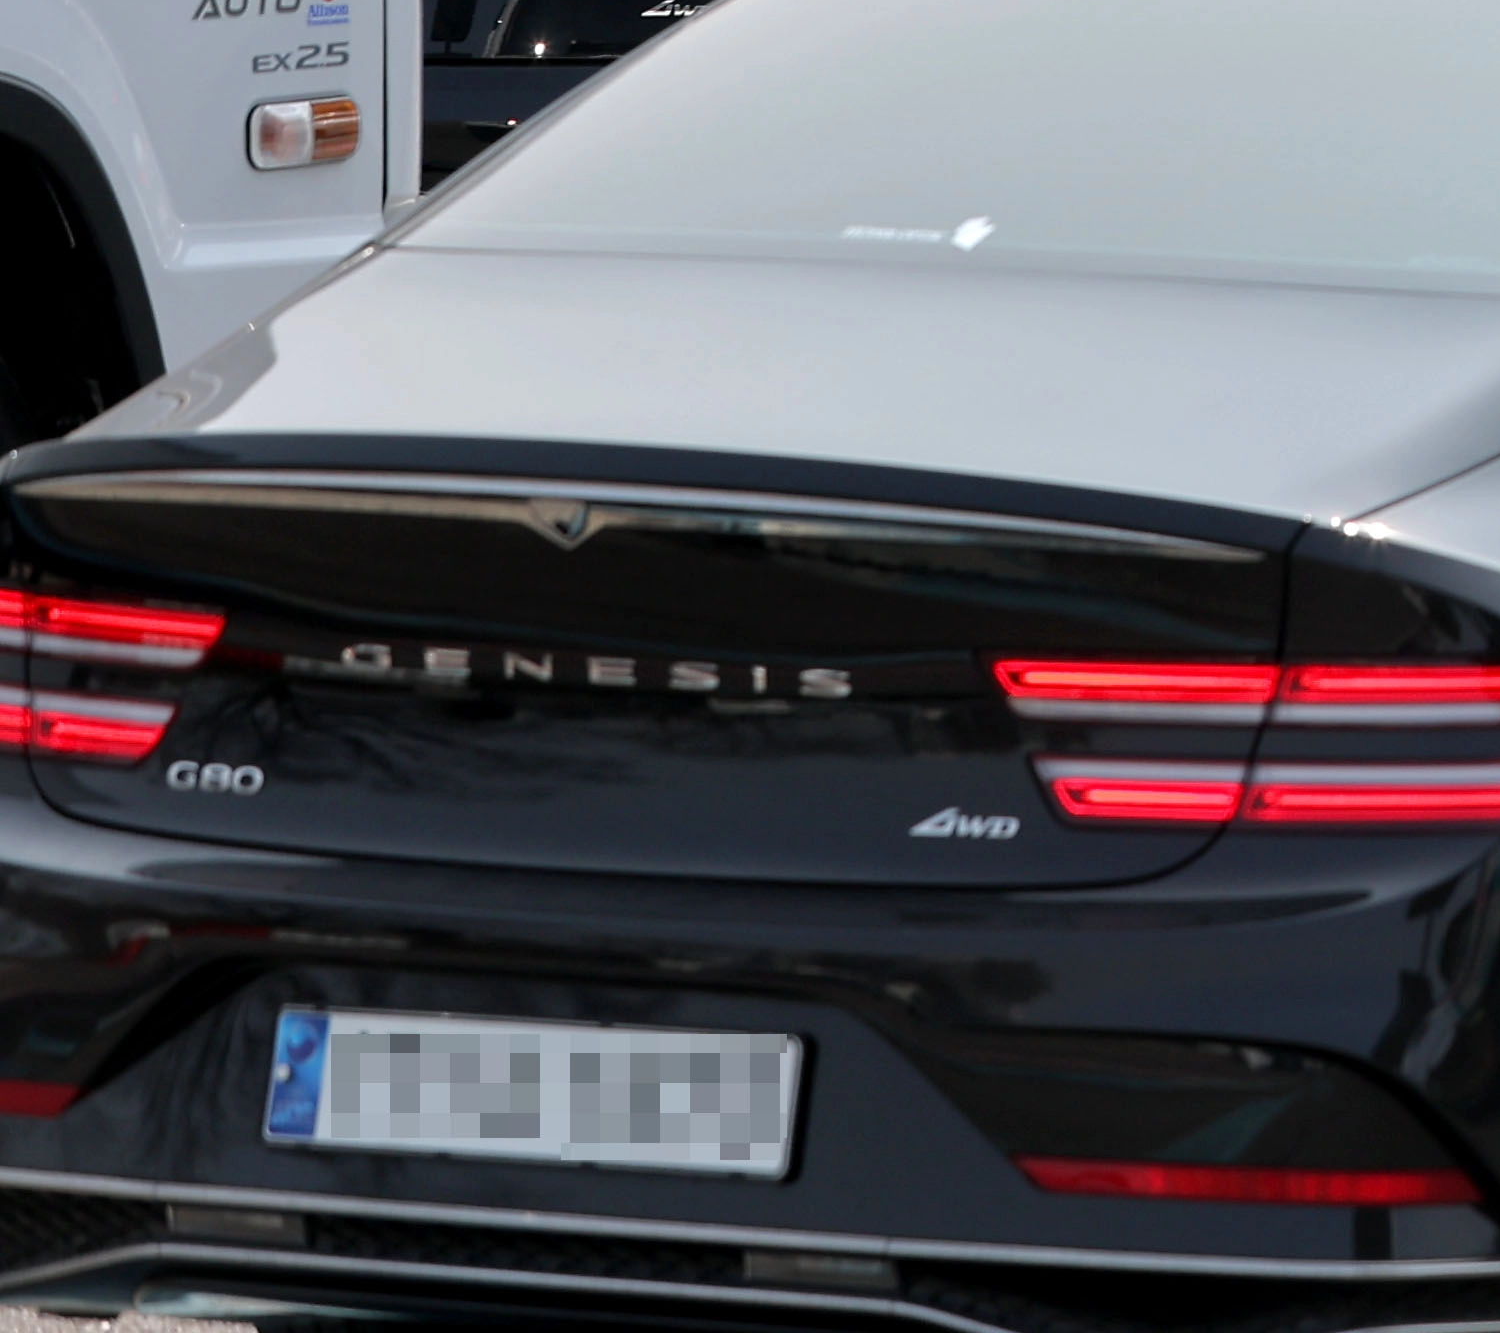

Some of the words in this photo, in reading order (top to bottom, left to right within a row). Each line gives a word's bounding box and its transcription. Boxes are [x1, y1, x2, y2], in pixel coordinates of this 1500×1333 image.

[342, 643, 852, 700] GENESIS
[166, 758, 266, 796] G80
[908, 805, 1021, 840] 4WD
